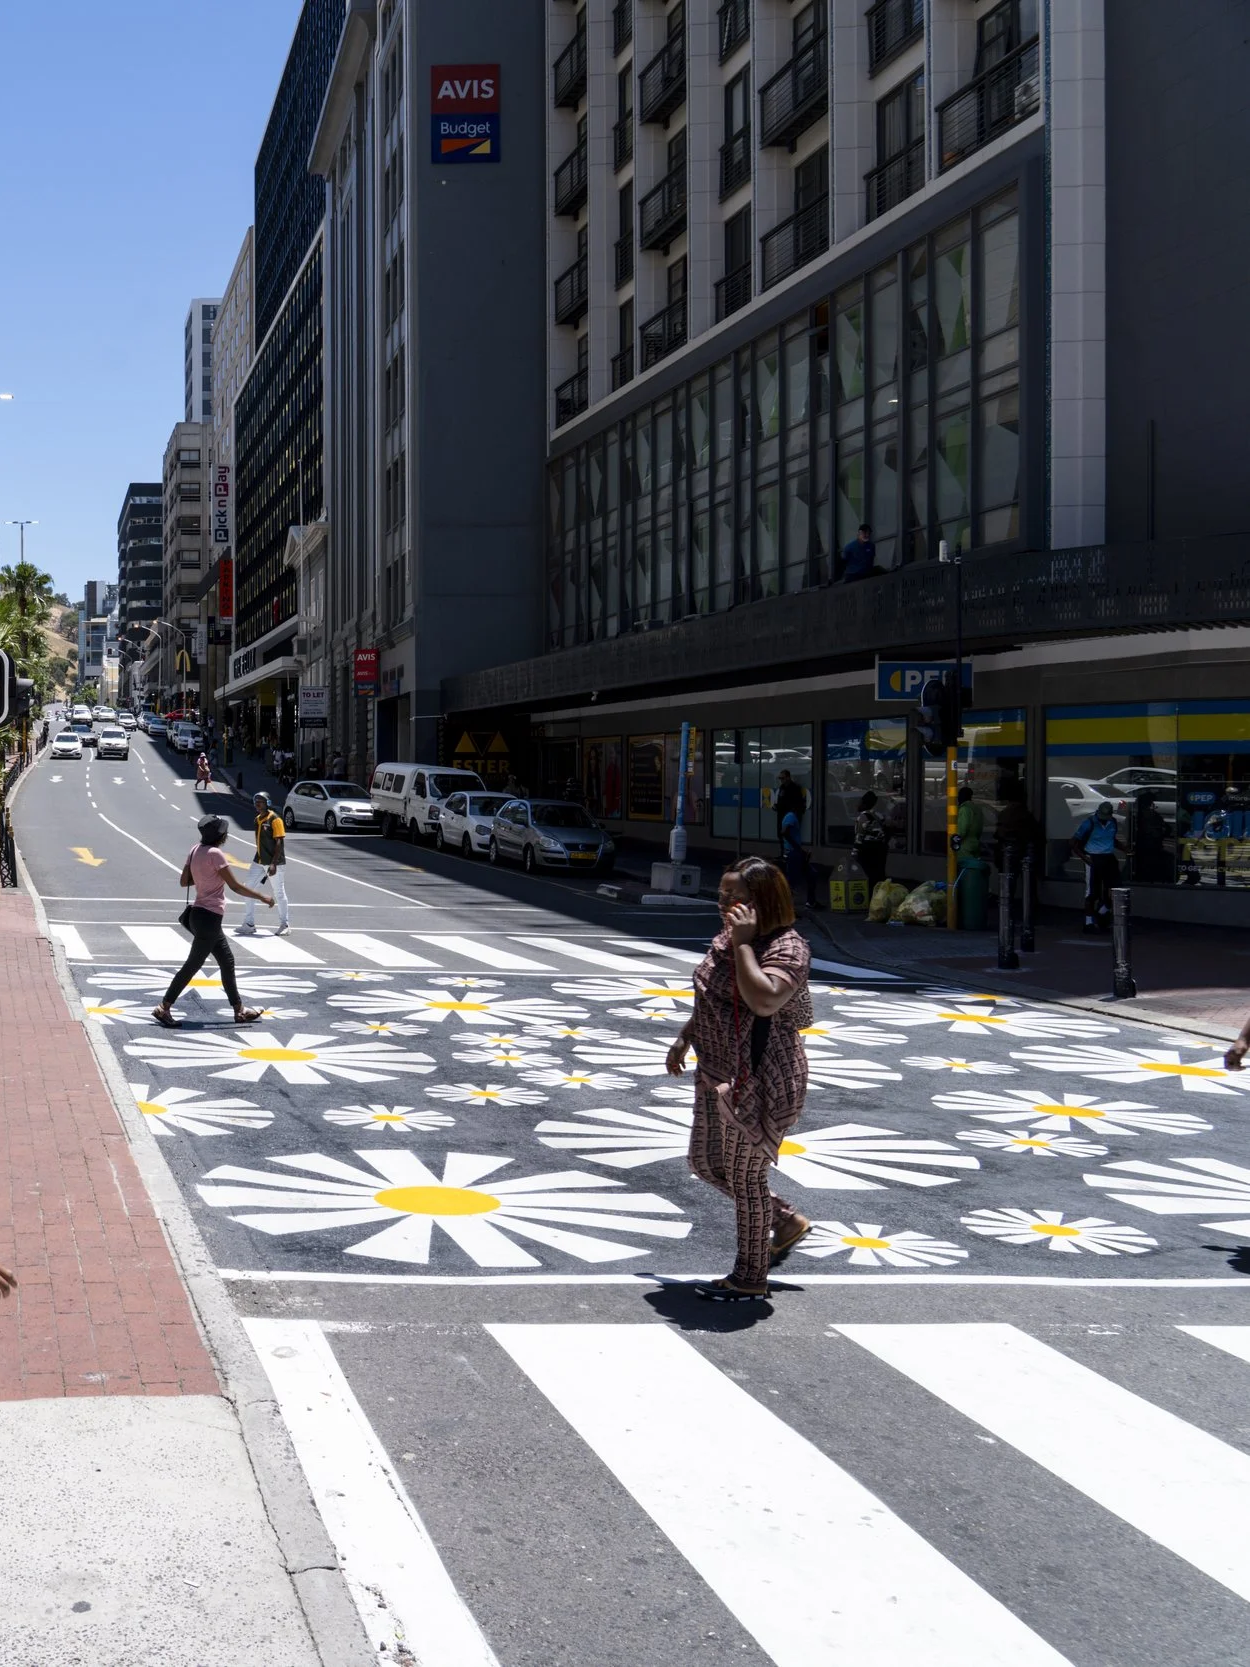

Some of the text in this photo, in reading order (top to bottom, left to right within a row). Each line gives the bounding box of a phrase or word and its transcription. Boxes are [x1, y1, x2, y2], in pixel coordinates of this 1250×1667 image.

[437, 79, 495, 100] AVIS
[440, 121, 491, 138] Budget
[214, 466, 230, 497] Pay
[214, 511, 229, 542] Pick
[356, 653, 376, 661] AVIS
[904, 669, 947, 692] PE
[1195, 794, 1214, 802] PEP
